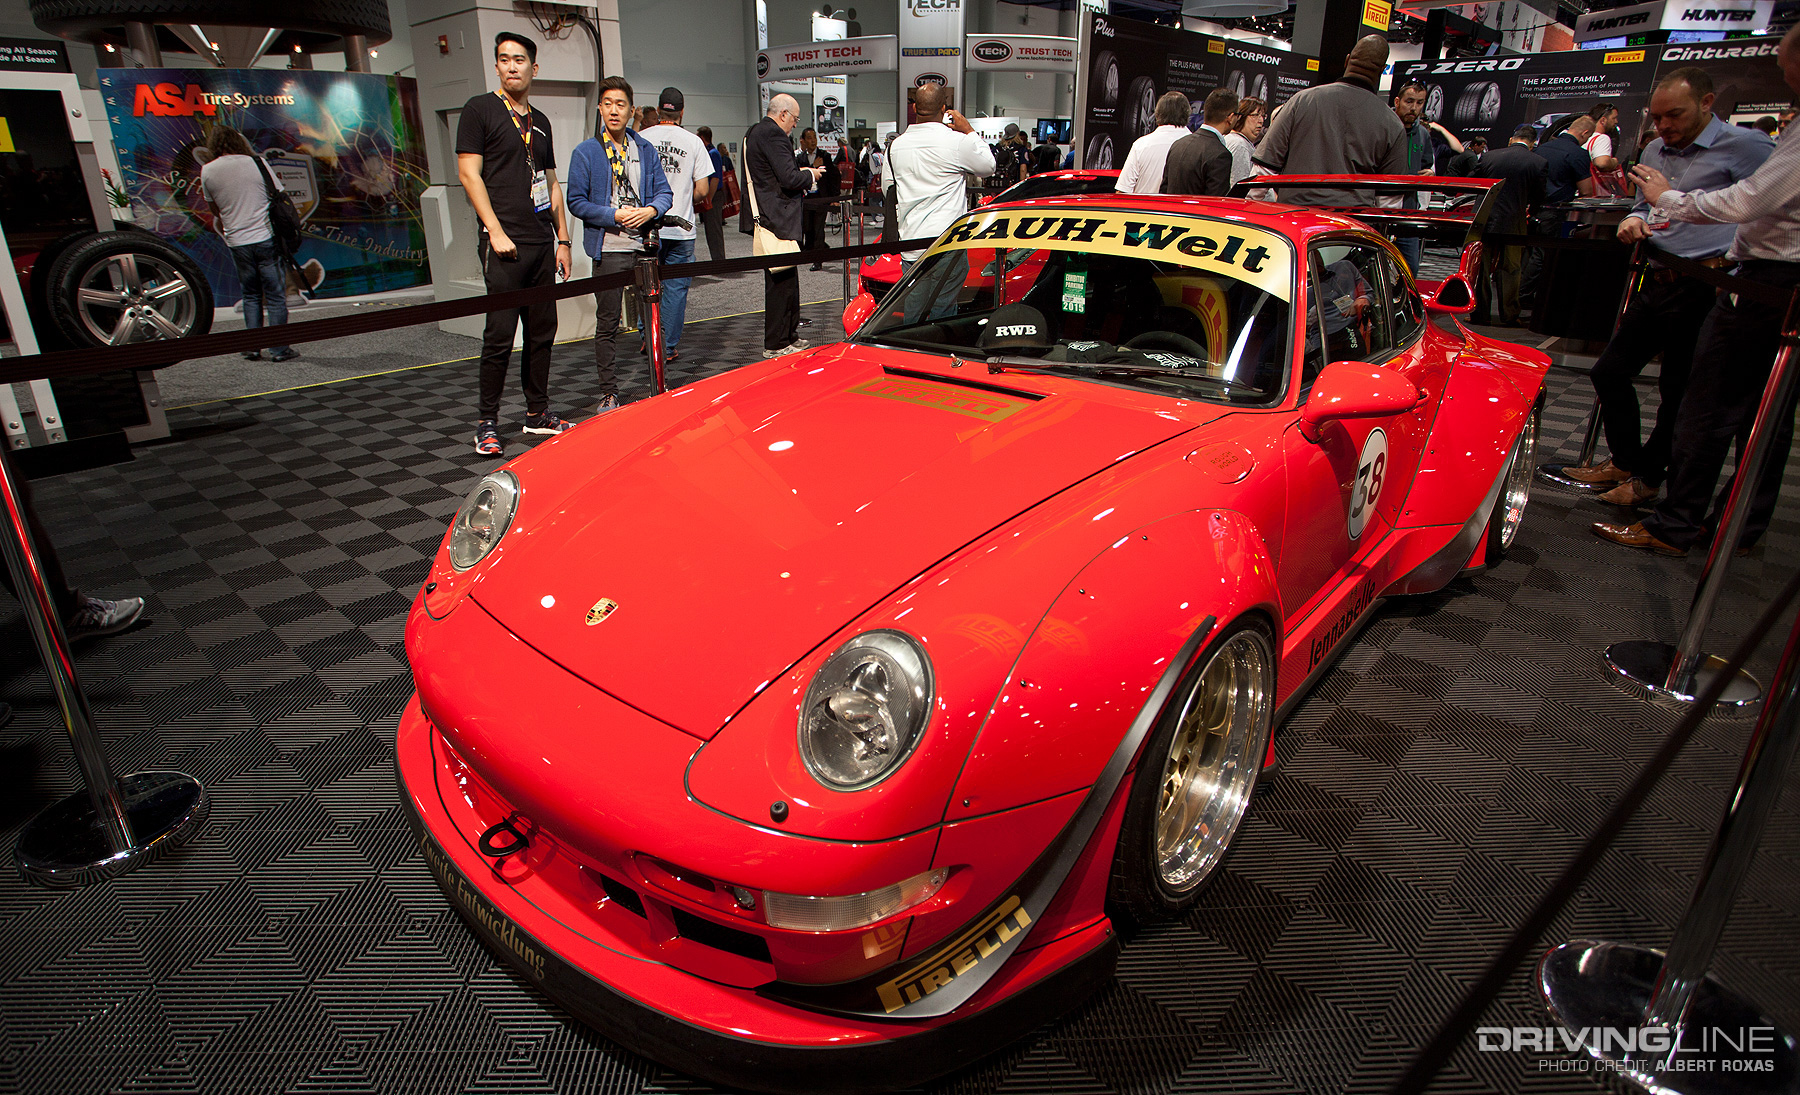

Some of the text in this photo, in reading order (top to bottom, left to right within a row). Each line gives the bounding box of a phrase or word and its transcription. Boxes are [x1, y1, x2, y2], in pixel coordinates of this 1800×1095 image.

[1366, 1, 1389, 26] PIRELLI
[1682, 9, 1756, 21] HUNTER
[1095, 18, 1116, 38] Plus
[1586, 12, 1650, 32] HUNTER
[28, 48, 57, 56] Season
[785, 46, 861, 62] TRUST TECH
[978, 47, 1007, 56] TECH
[1019, 47, 1072, 57] TRUST TECH
[1227, 47, 1279, 66] SCORPION
[1607, 52, 1641, 62] PIRELLI
[26, 56, 56, 64] Season
[779, 58, 872, 72] www.techtirerepairs.com
[1405, 63, 1428, 75] P
[1430, 58, 1526, 74] ZERO
[1572, 75, 1606, 83] FAMILY
[133, 82, 216, 117] ASA
[200, 92, 295, 108] Tire Systems
[326, 225, 358, 247] Tire
[364, 238, 423, 266] Industry
[942, 216, 1271, 274] RAUH-Welt
[1063, 301, 1084, 312] 2015
[995, 325, 1037, 337] RWB
[862, 381, 1010, 416] PIRELLI
[1352, 452, 1386, 518] 38
[457, 879, 546, 979] Entwicklung
[875, 895, 1032, 1014] PIRELLI
